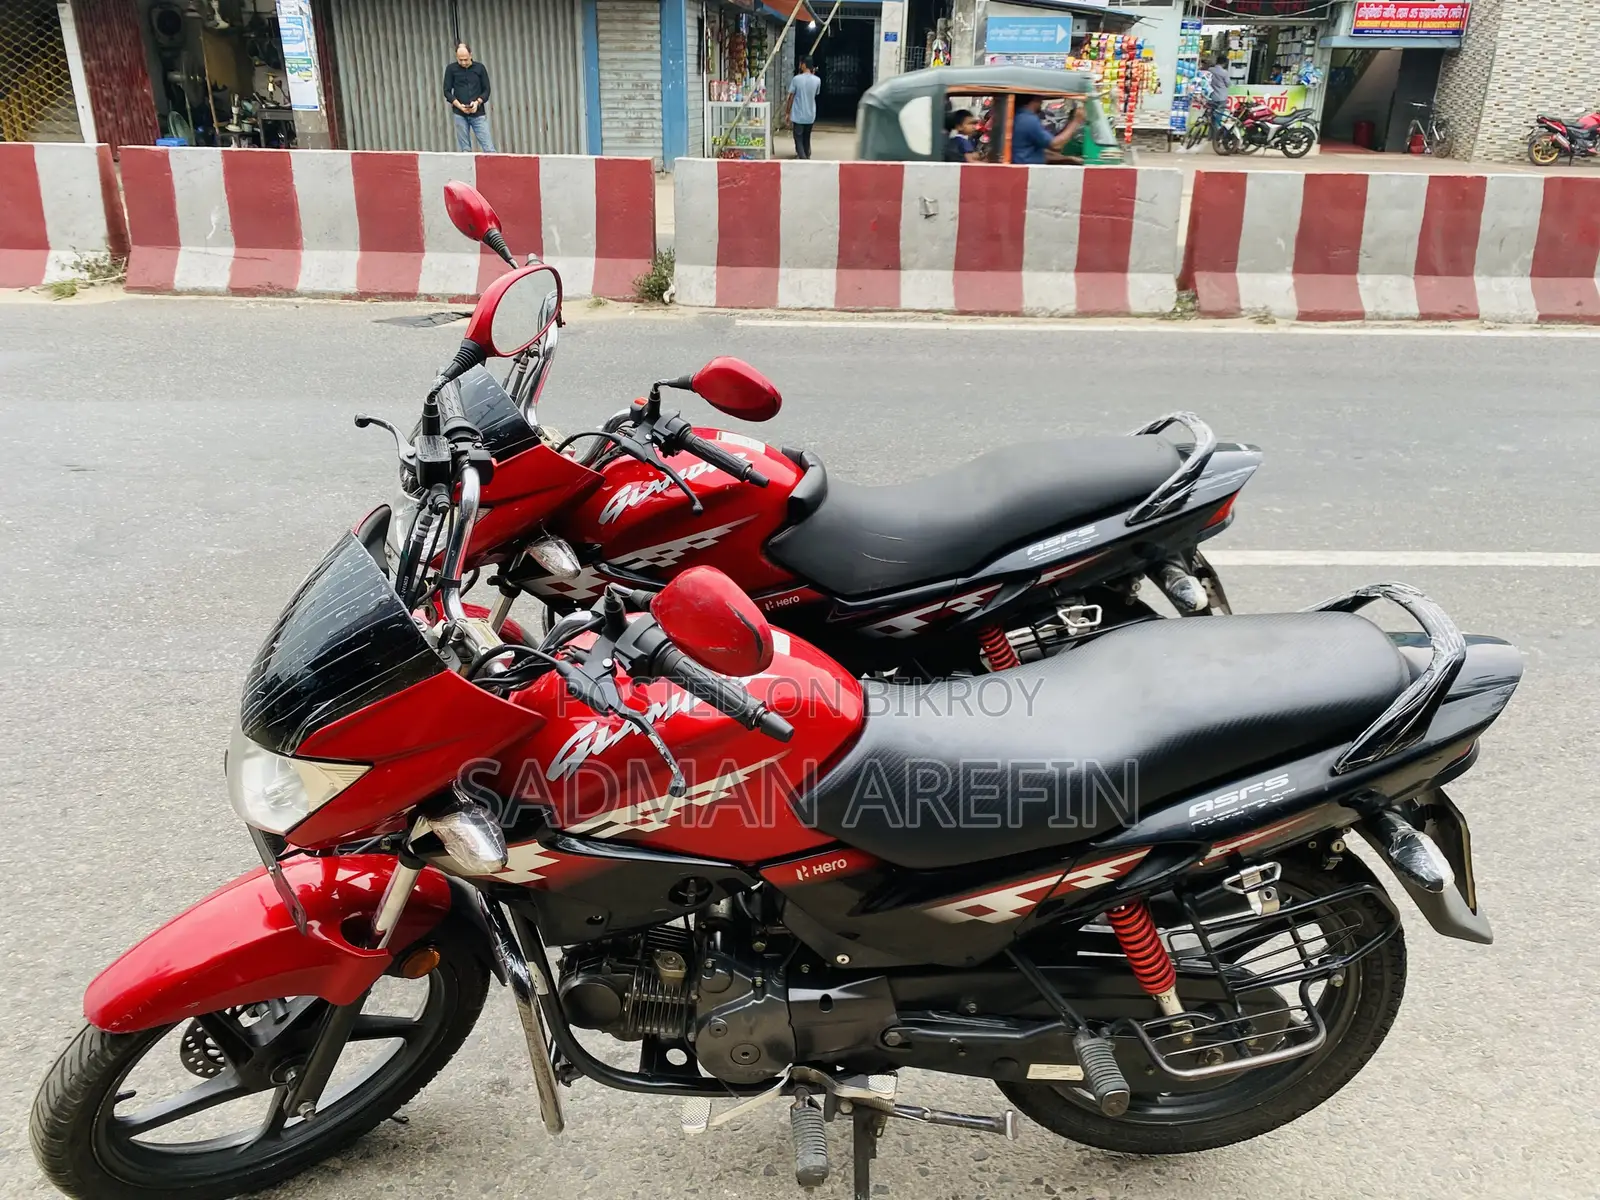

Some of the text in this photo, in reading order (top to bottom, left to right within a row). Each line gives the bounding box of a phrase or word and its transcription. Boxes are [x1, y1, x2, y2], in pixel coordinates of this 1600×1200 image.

[775, 595, 800, 608] Hero
[1188, 773, 1290, 818] ASFS
[812, 858, 848, 875] Hero
